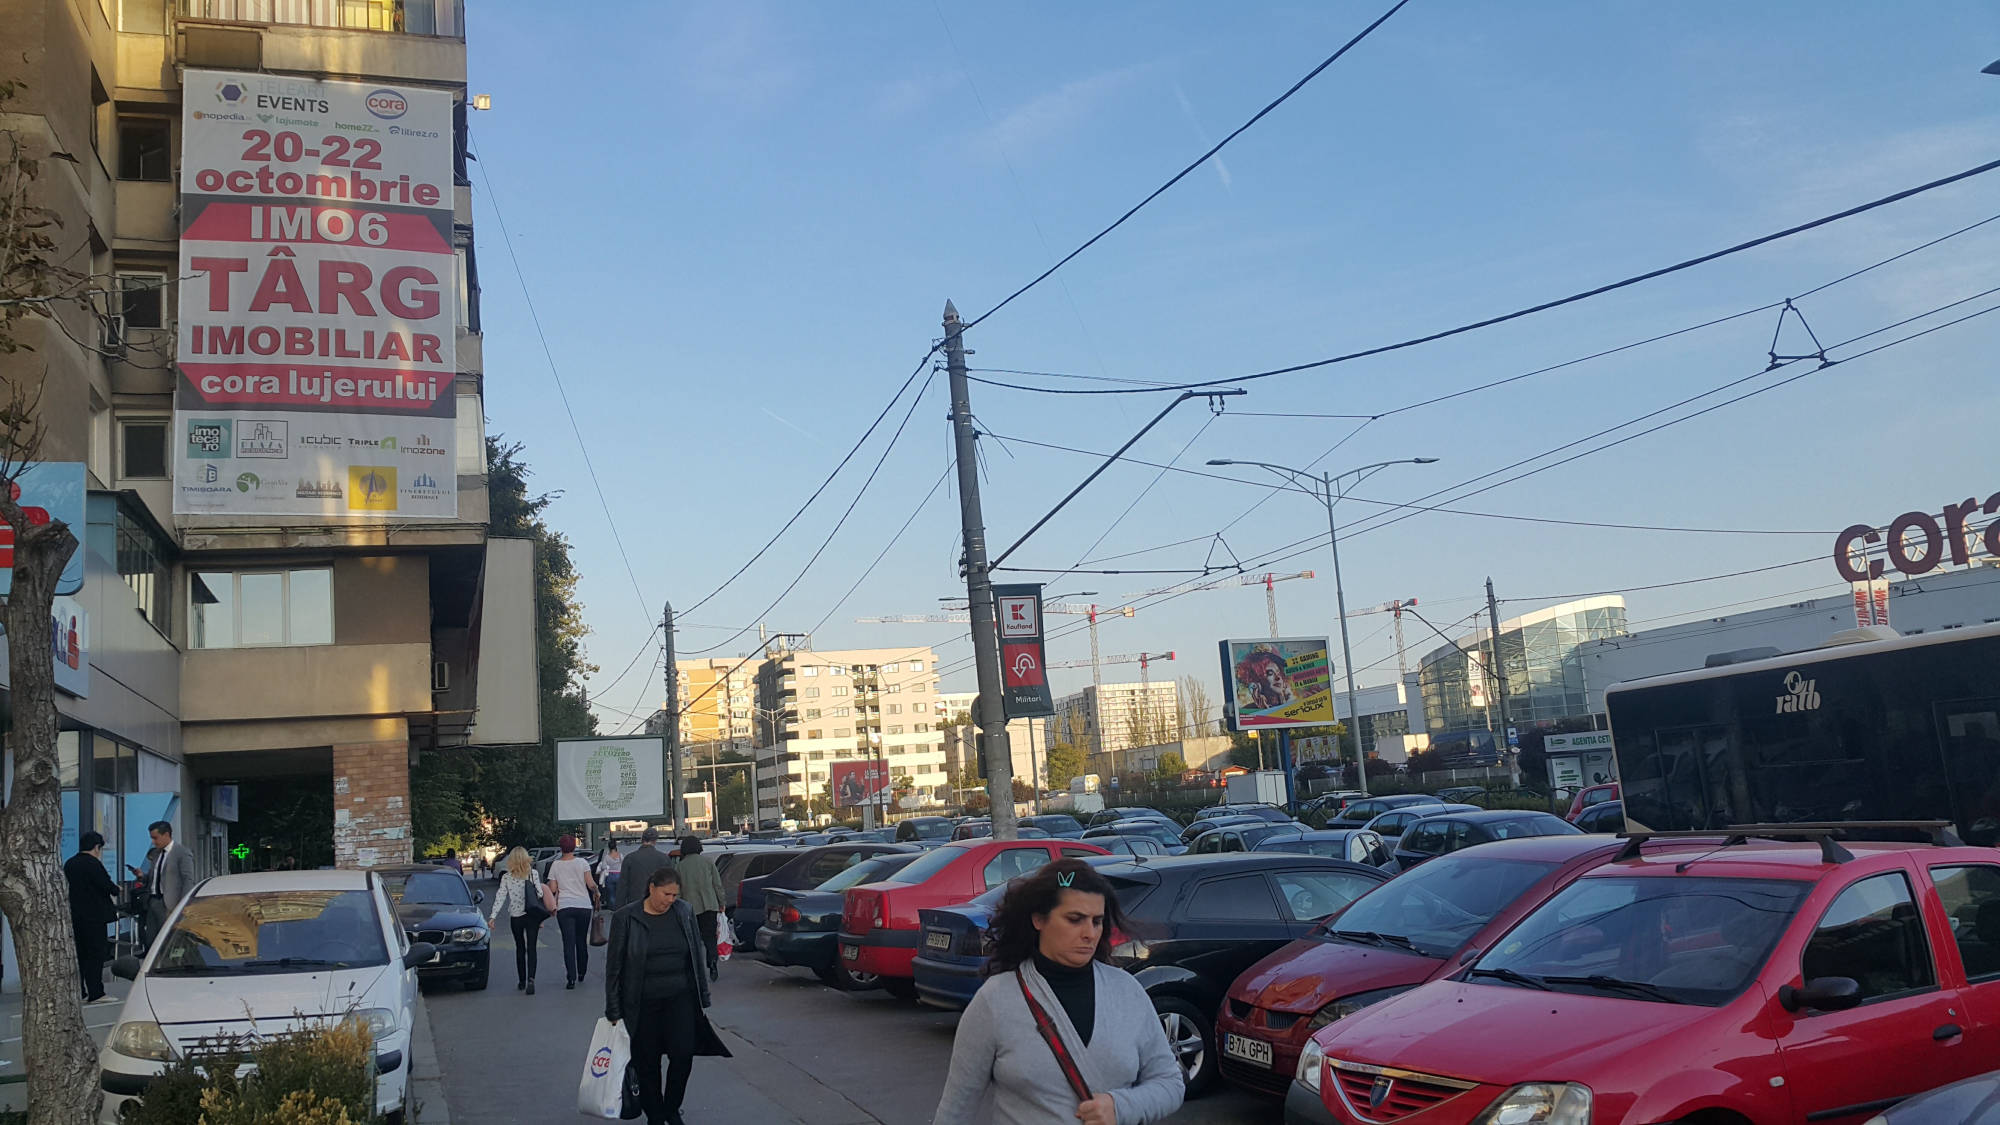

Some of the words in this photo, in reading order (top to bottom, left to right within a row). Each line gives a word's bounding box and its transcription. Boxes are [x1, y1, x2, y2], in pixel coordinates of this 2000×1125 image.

[256, 94, 329, 114] EVENTS
[368, 96, 406, 112] cora
[241, 129, 382, 171] 20-22
[195, 164, 441, 206] octombrie
[250, 206, 389, 246] IMO6
[190, 245, 441, 320] TÂRG
[191, 325, 443, 364] IMOBILIAR
[200, 374, 281, 395] cora
[289, 369, 437, 403] lujerului
[190, 434, 220, 445] teca
[195, 425, 220, 436] imo
[201, 443, 220, 452] .ro
[1006, 622, 1033, 631] Kaufland
[1015, 695, 1042, 704] Militari
[1249, 1041, 1269, 1062] GPH
